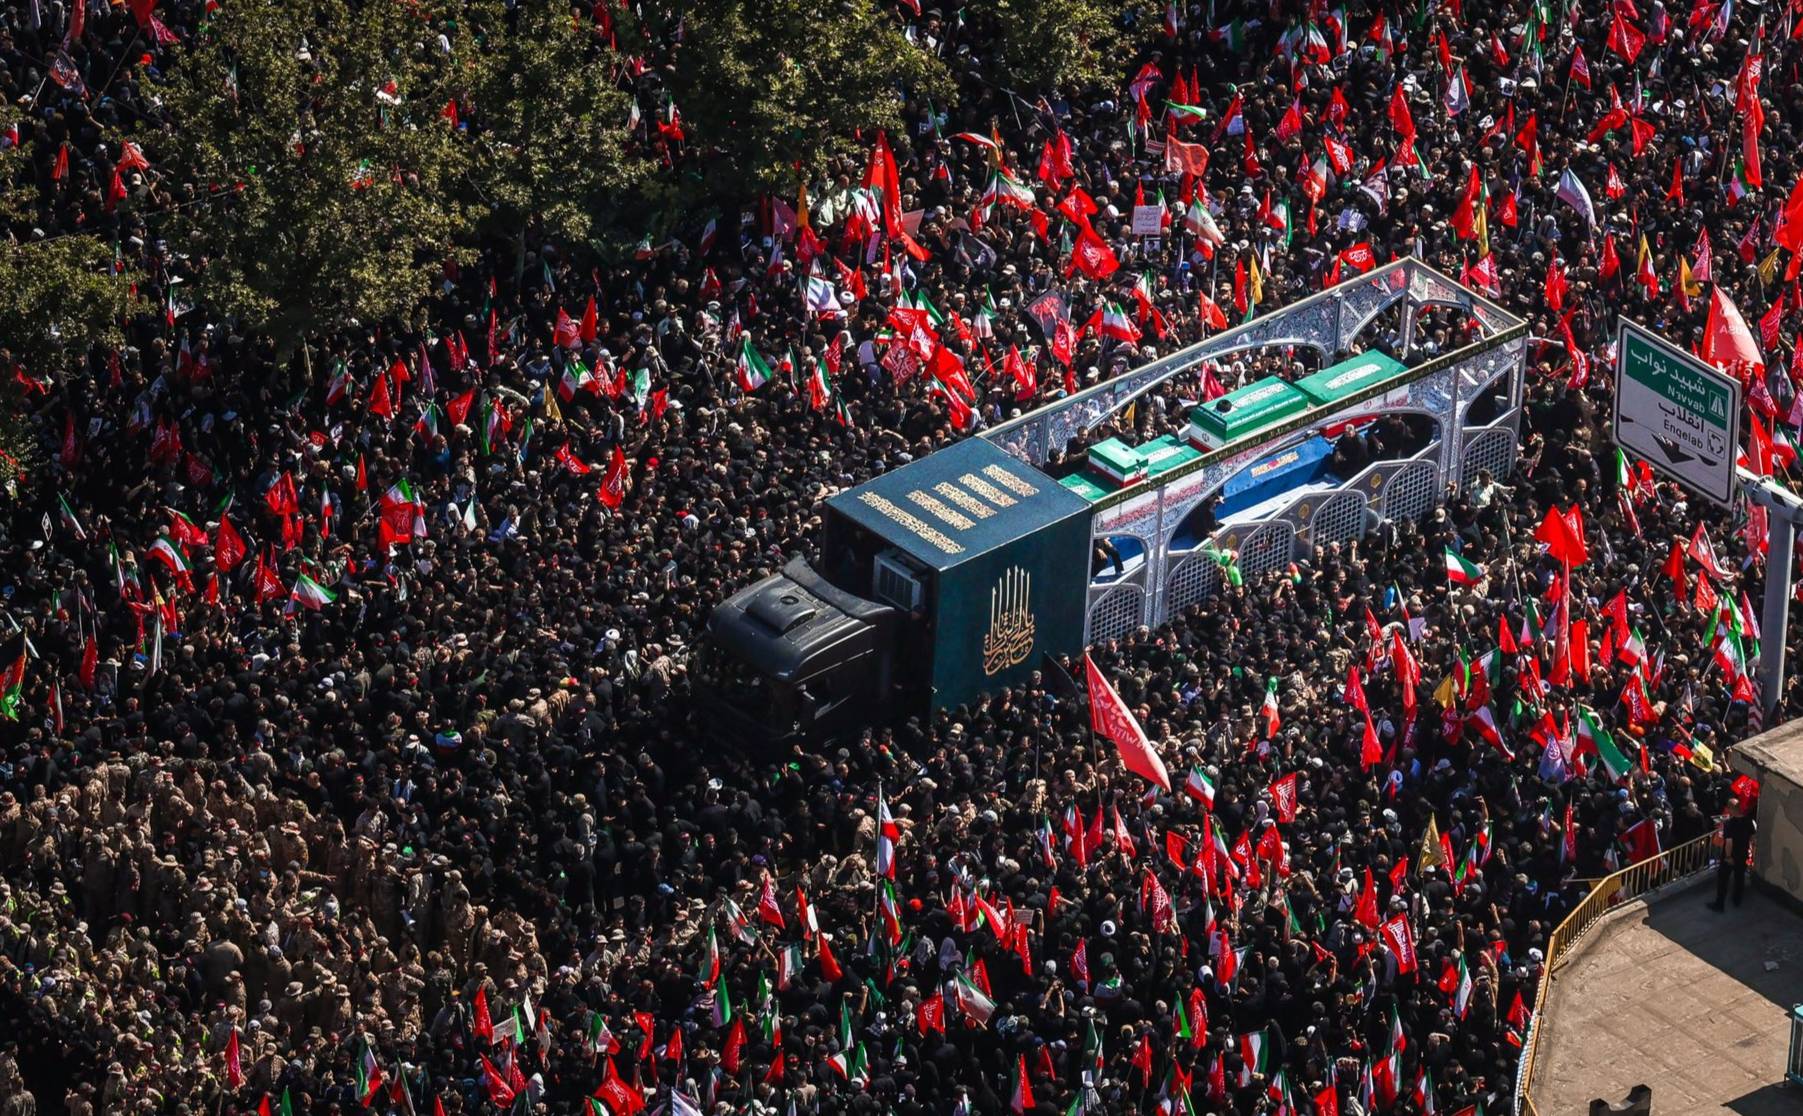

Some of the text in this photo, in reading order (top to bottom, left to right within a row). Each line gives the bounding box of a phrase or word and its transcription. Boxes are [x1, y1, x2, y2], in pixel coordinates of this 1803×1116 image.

[1630, 349, 1706, 396] شهید نواب
[1657, 402, 1705, 433] انقلاب
[1663, 418, 1704, 449] Enqelab
